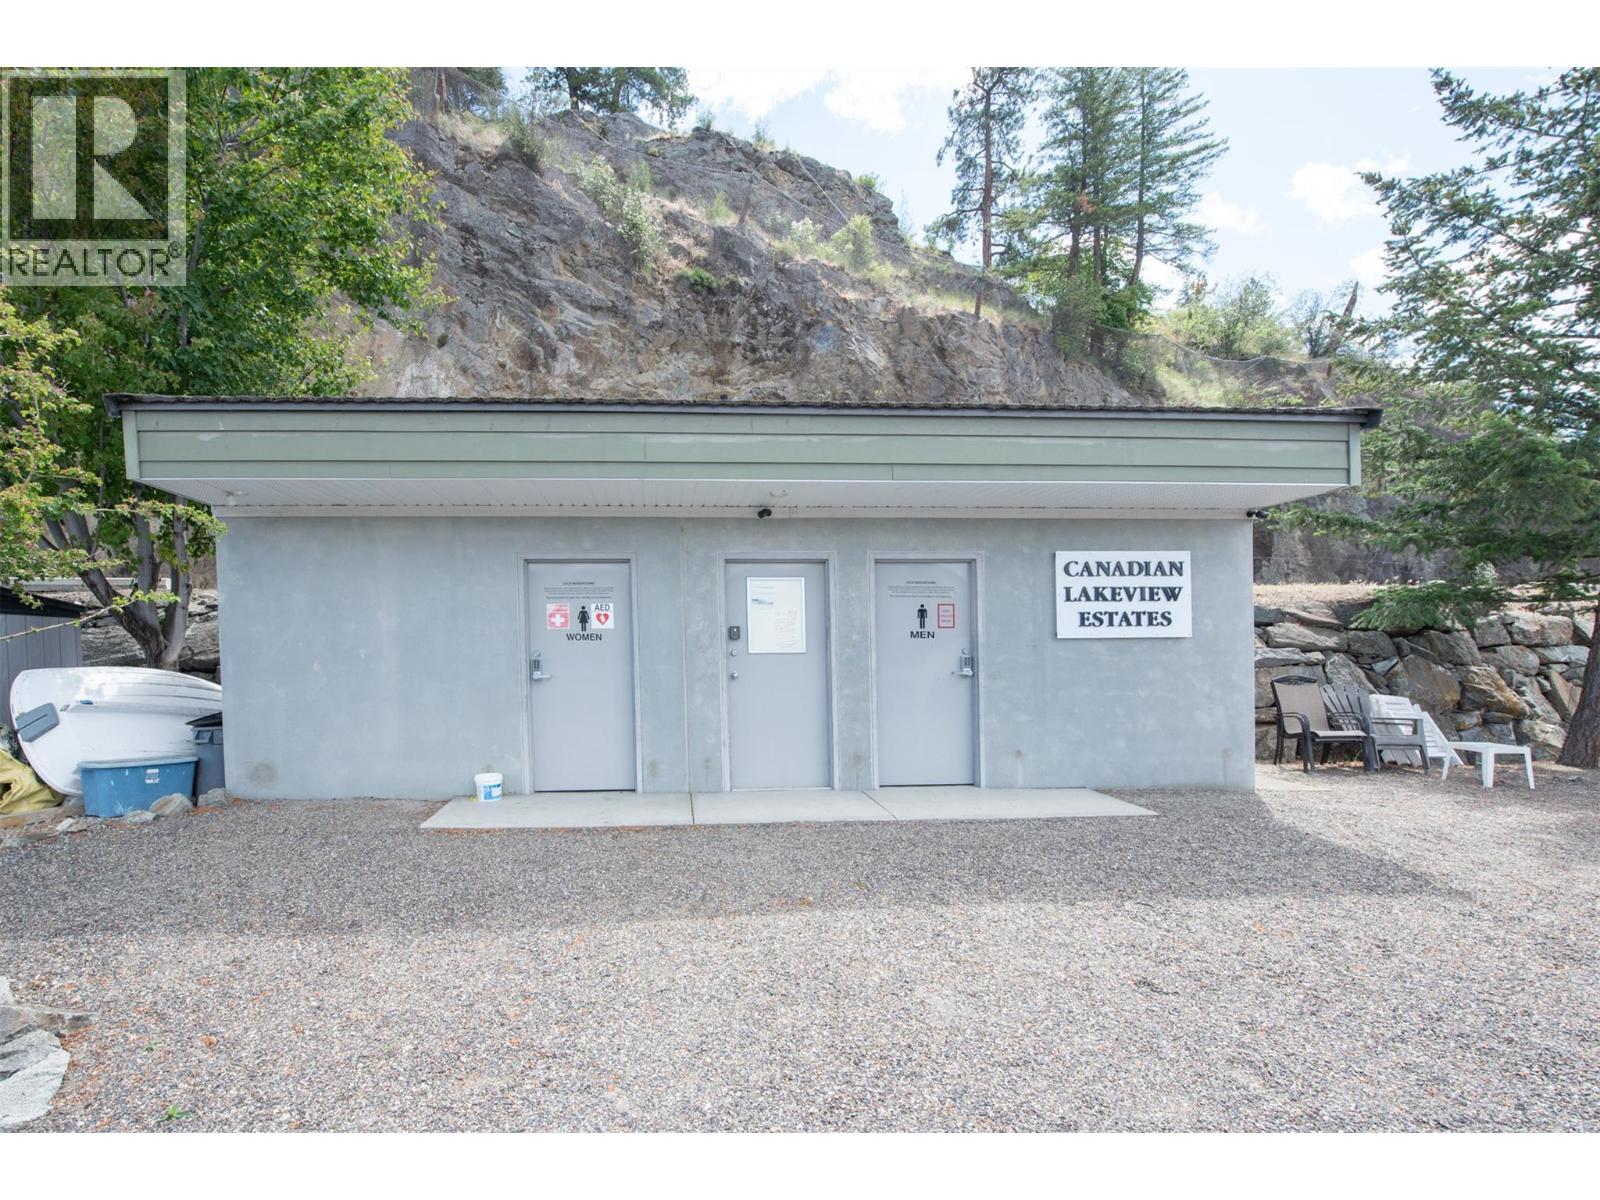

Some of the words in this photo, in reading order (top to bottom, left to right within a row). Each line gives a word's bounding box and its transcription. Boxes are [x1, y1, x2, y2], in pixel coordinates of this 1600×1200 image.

[1063, 560, 1184, 577] CANADIAN
[1063, 586, 1184, 602] LAKEVIEW
[1078, 610, 1173, 627] ESTATES
[566, 633, 602, 641] WOMEN
[910, 631, 935, 639] MEN
